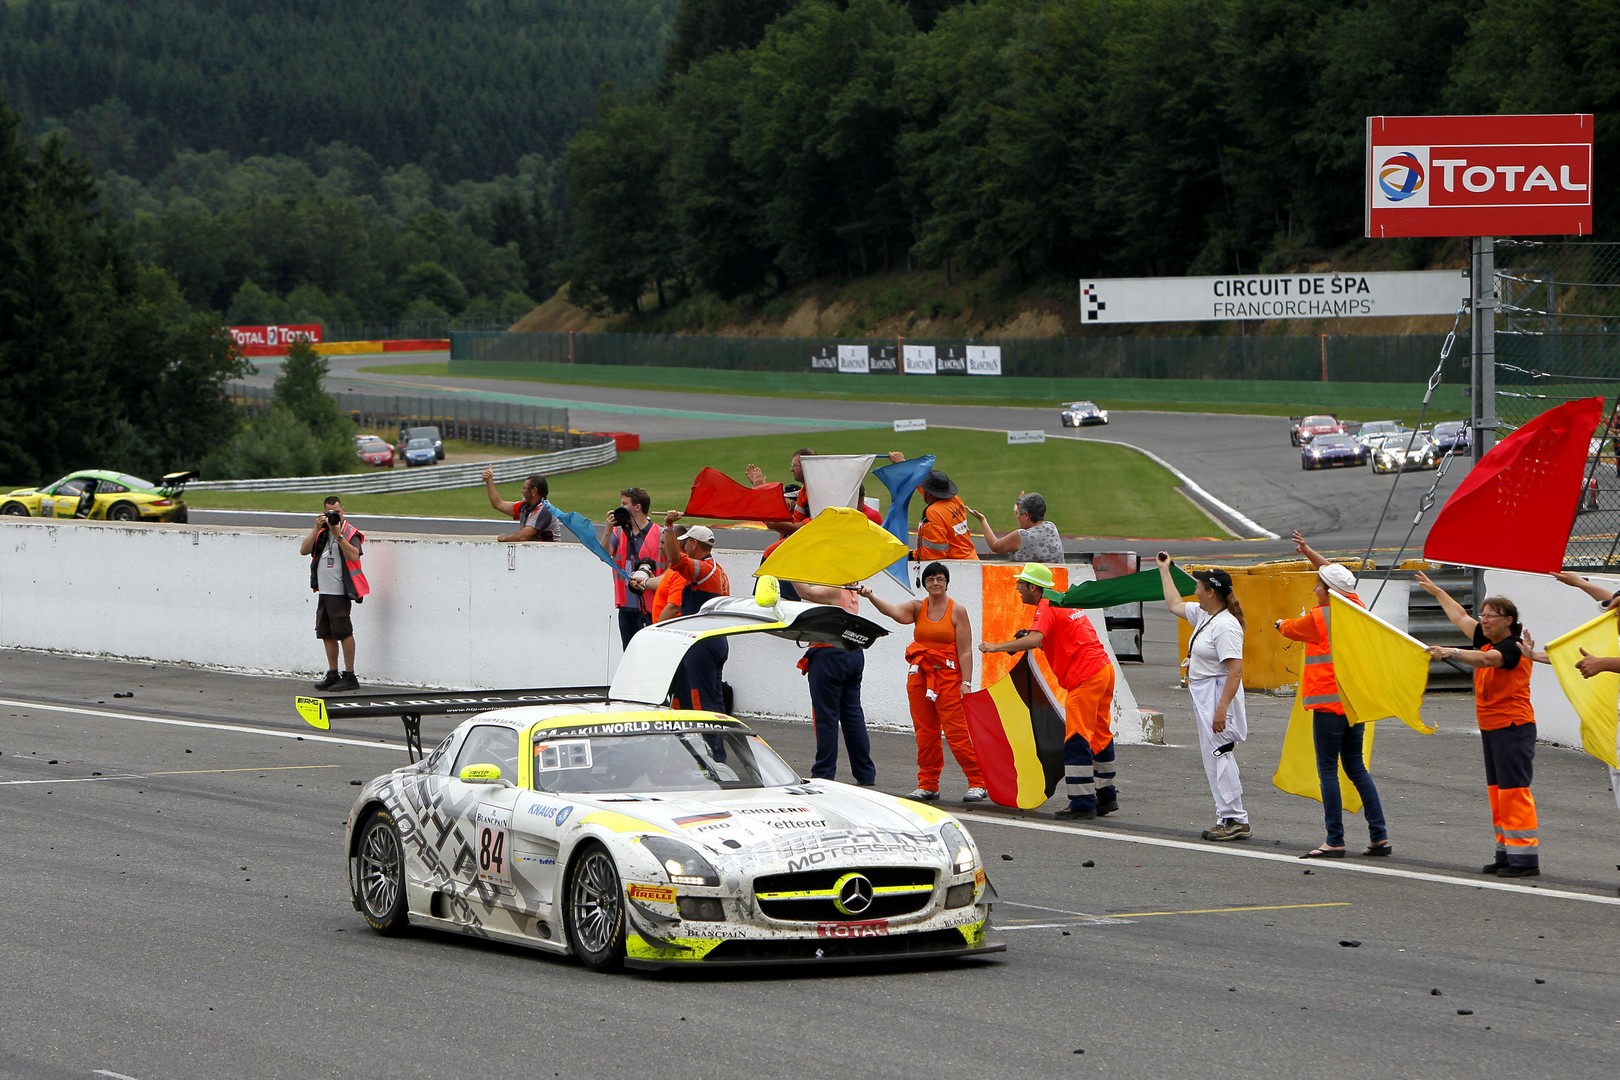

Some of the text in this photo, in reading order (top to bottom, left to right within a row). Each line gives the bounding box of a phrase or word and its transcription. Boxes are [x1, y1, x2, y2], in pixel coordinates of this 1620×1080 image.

[1432, 159, 1587, 193] TOTAL
[1213, 277, 1370, 297] CIRCUIT DE SPA
[230, 329, 265, 344] TOTAL
[970, 358, 998, 371] BLANCPAIN
[602, 721, 650, 734] WORLD
[527, 803, 558, 819] KNAUS
[476, 812, 508, 828] BLANCPAIN
[697, 822, 731, 833] PRO
[480, 827, 504, 874] 84
[630, 885, 673, 900] PIRELLI
[943, 915, 977, 928] BLANCPAIN
[687, 929, 747, 938] BLANCPAIN
